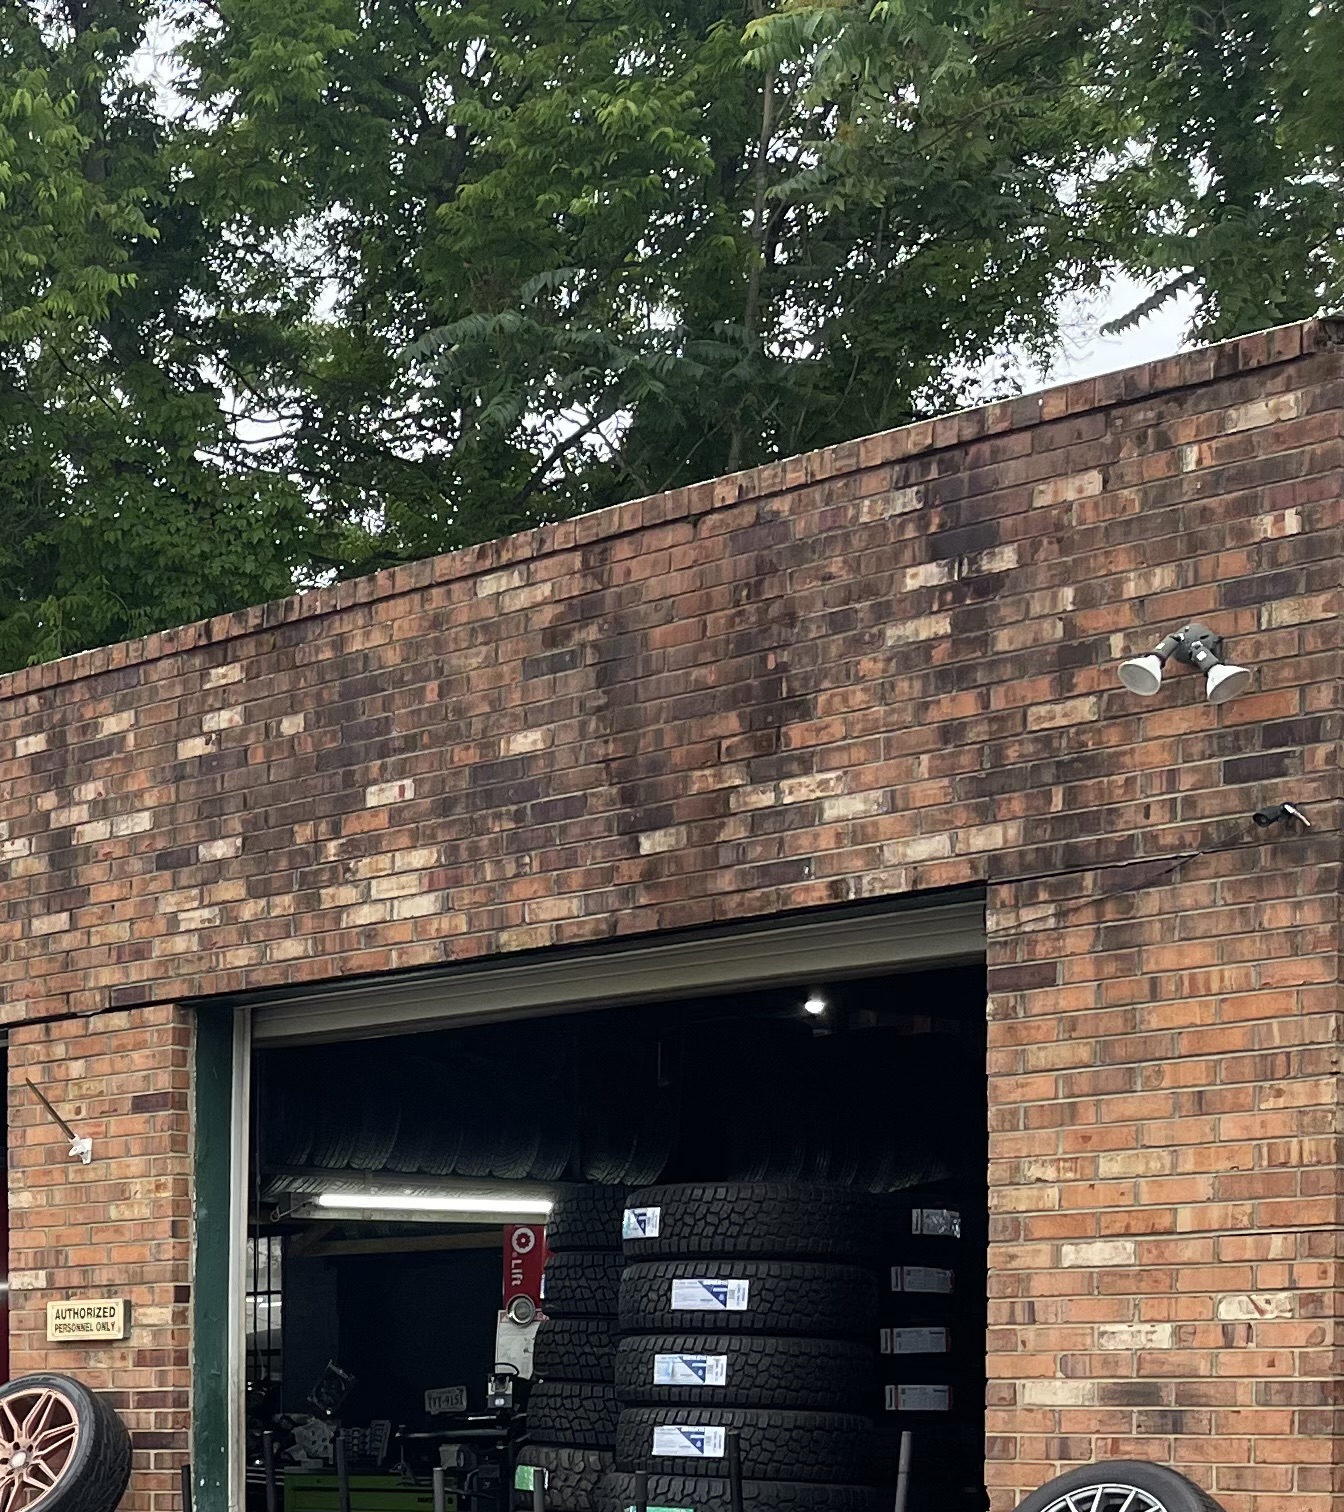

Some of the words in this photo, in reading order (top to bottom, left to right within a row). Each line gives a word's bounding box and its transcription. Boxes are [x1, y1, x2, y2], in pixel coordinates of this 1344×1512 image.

[55, 1306, 116, 1321] AUTHORIZED
[55, 1322, 94, 1333] PERSONNEL
[96, 1321, 116, 1332] ONLY
